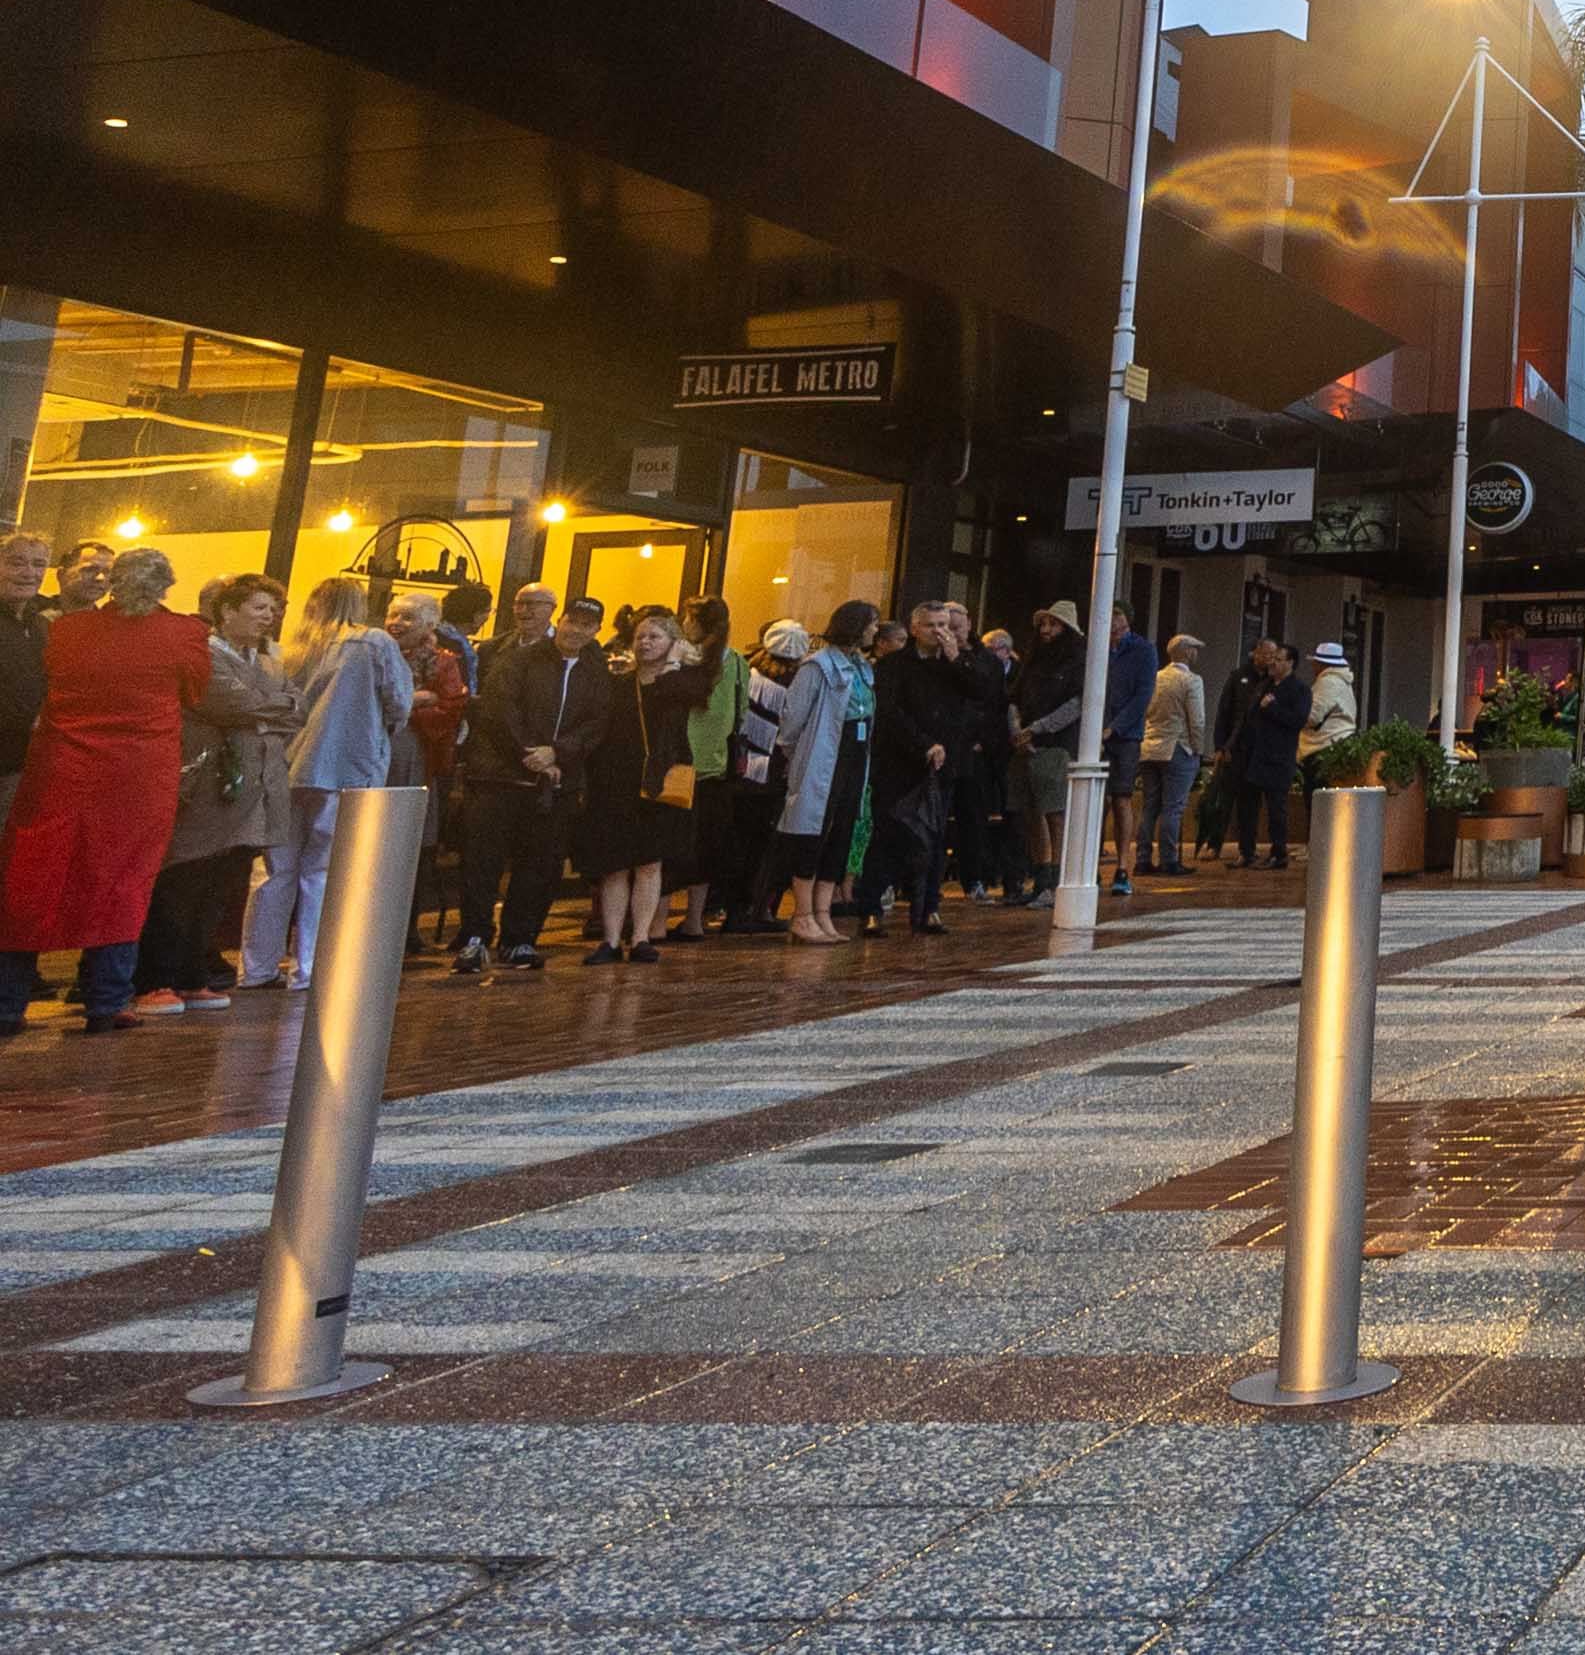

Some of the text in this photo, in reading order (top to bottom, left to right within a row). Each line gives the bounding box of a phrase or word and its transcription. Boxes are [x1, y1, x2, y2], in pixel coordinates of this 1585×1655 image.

[681, 360, 879, 397] FALAFEL METRO
[636, 460, 671, 473] FOLK
[1156, 489, 1296, 512] Tonkin+Taylor
[1468, 483, 1522, 504] George
